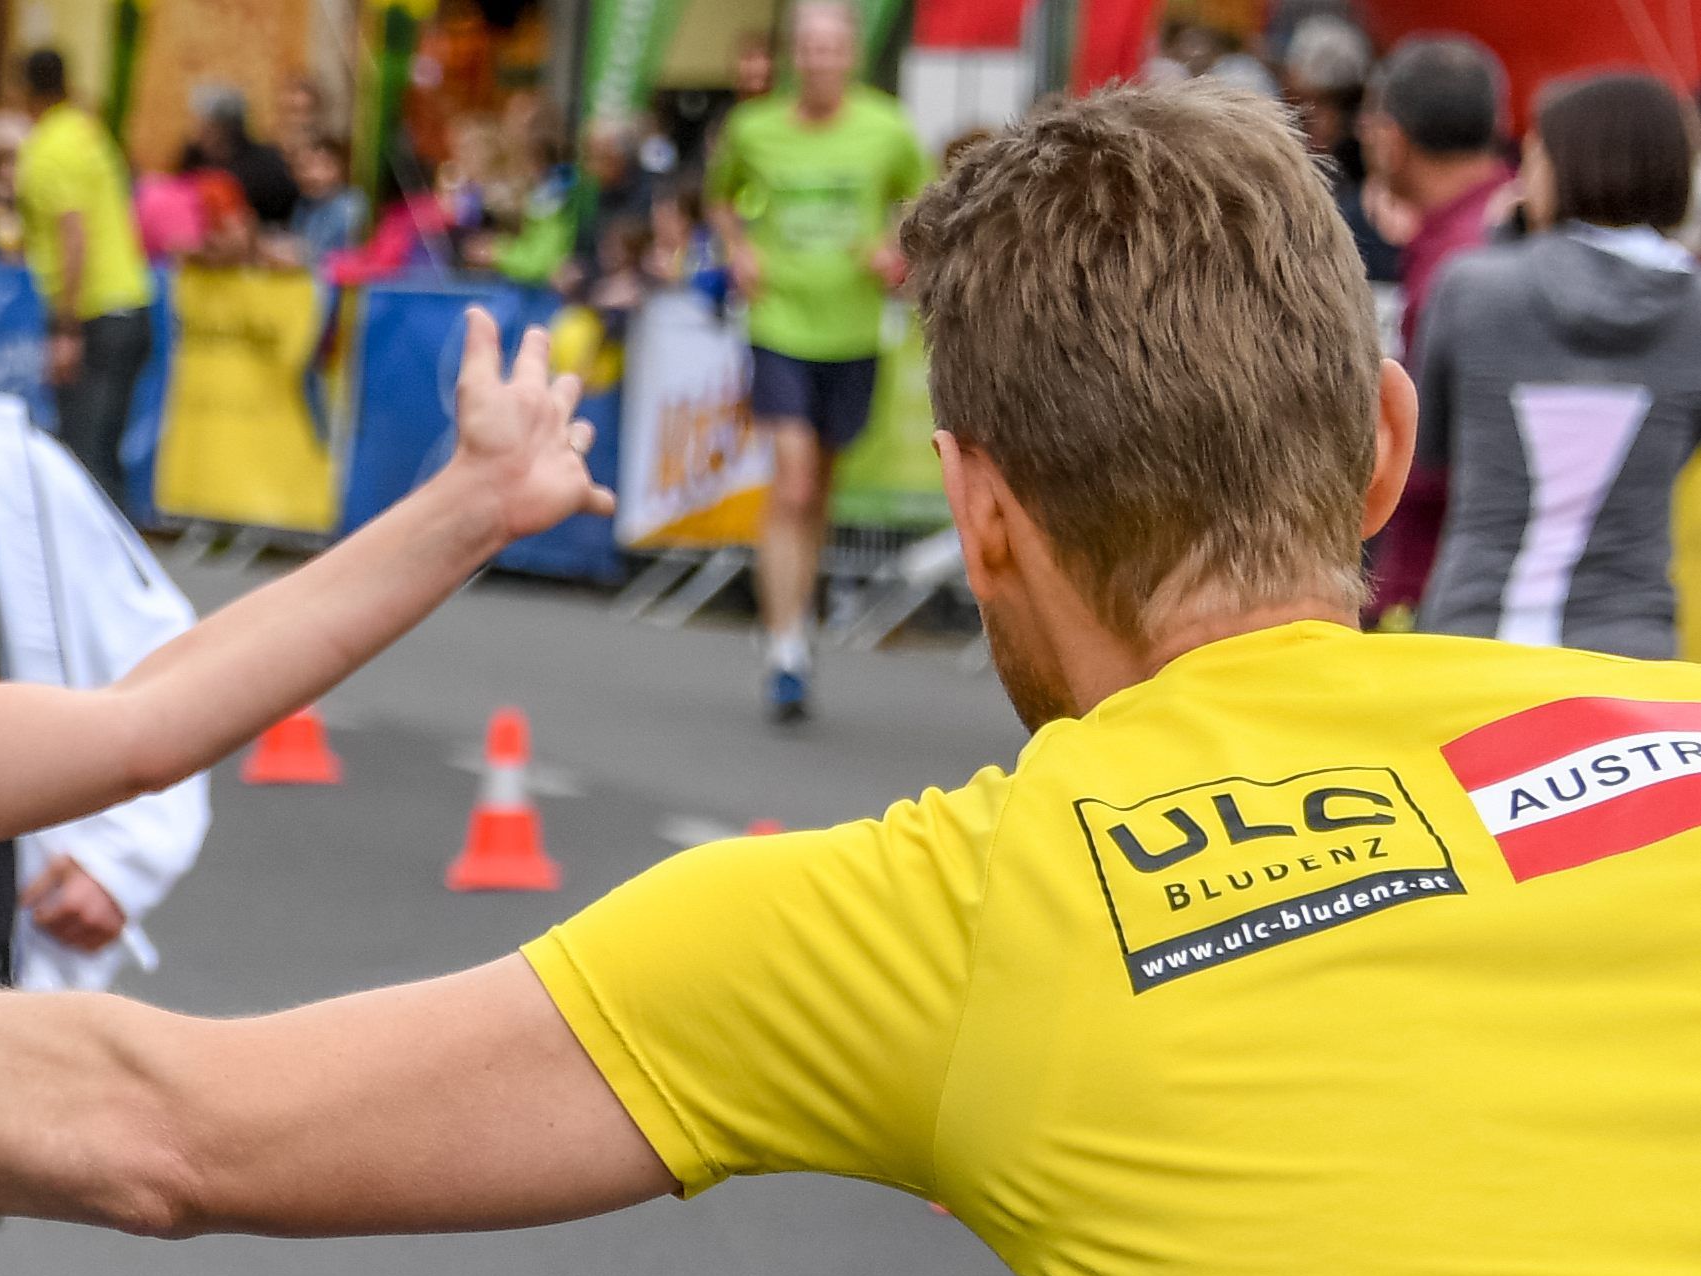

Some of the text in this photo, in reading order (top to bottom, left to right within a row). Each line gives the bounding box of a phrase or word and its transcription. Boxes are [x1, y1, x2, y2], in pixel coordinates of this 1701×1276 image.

[1509, 740, 1701, 820] AUSTR
[1106, 787, 1397, 874] ULC
[1163, 836, 1389, 912] BLUDENZ
[1141, 874, 1450, 978] www.ulc-bludenz.at
